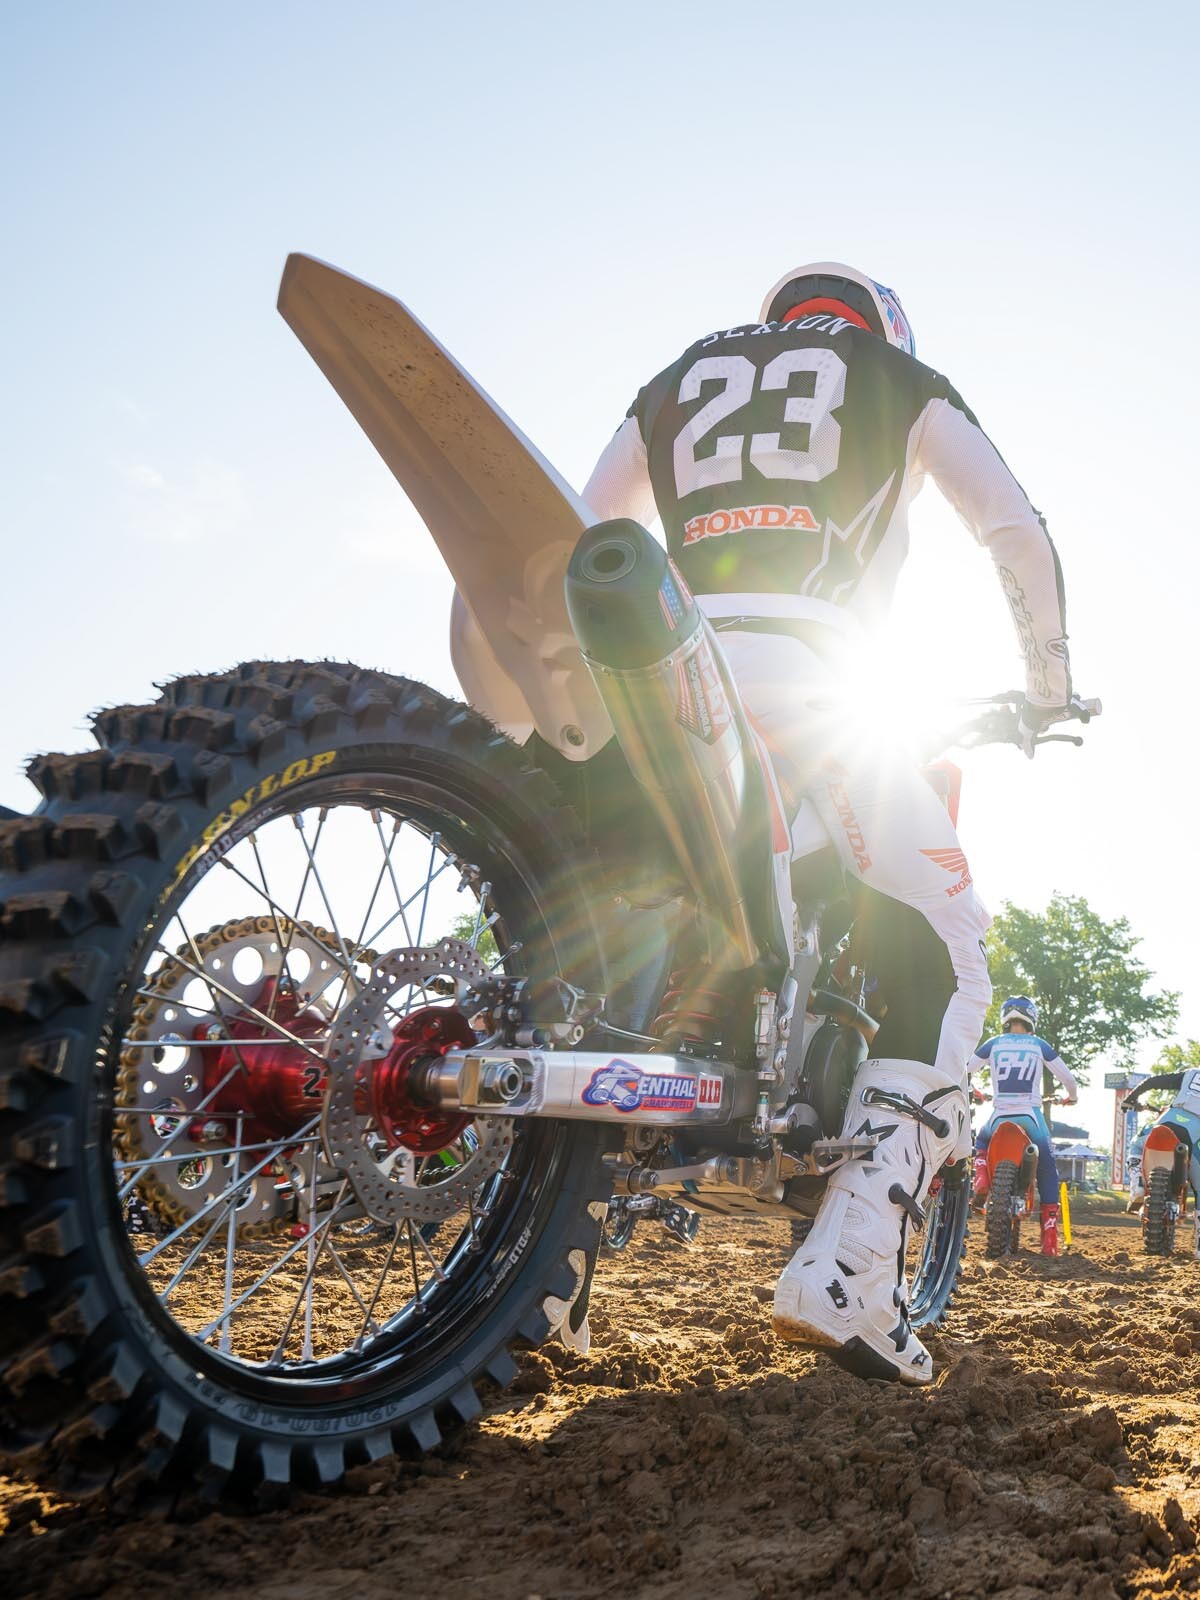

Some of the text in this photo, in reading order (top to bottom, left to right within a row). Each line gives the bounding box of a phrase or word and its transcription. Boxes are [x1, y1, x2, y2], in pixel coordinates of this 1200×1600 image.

[702, 315, 852, 348] SEXTON
[673, 347, 848, 500] 23
[682, 505, 821, 547] HONDA
